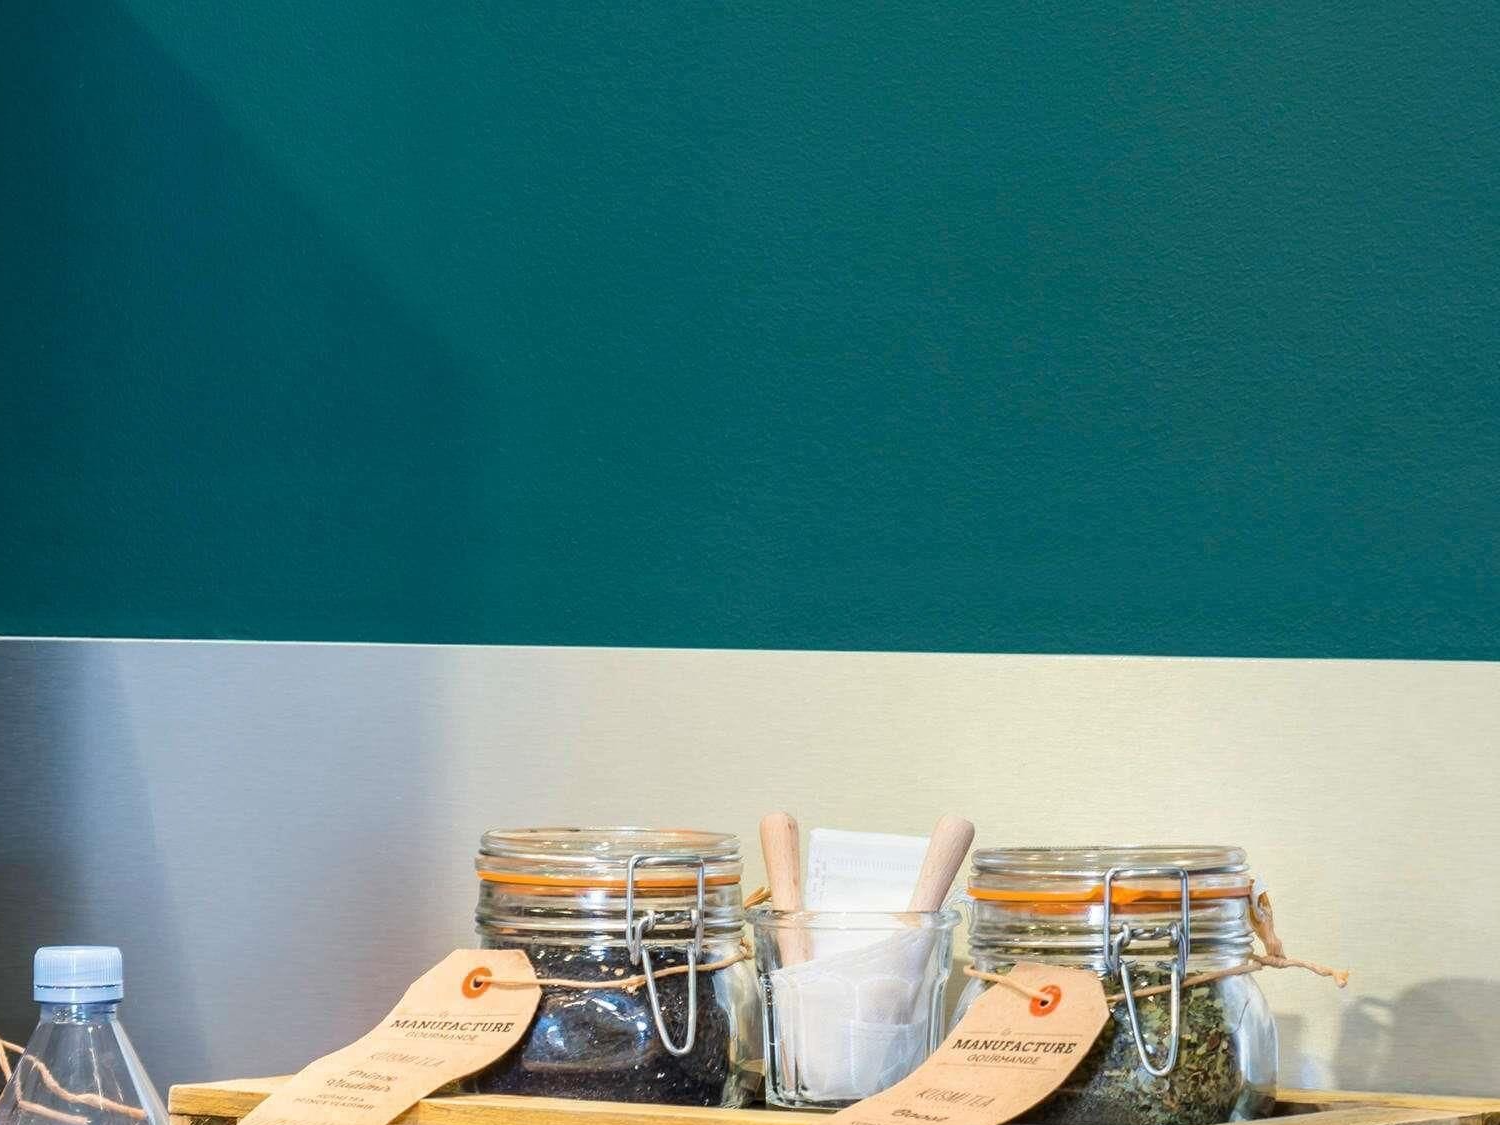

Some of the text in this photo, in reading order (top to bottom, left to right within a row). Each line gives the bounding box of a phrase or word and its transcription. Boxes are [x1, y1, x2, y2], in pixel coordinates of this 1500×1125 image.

[390, 1019, 515, 1033] MANUFACTURE
[952, 1039, 1077, 1055] MANUFACTURE
[966, 1054, 1042, 1065] GOURMANDE
